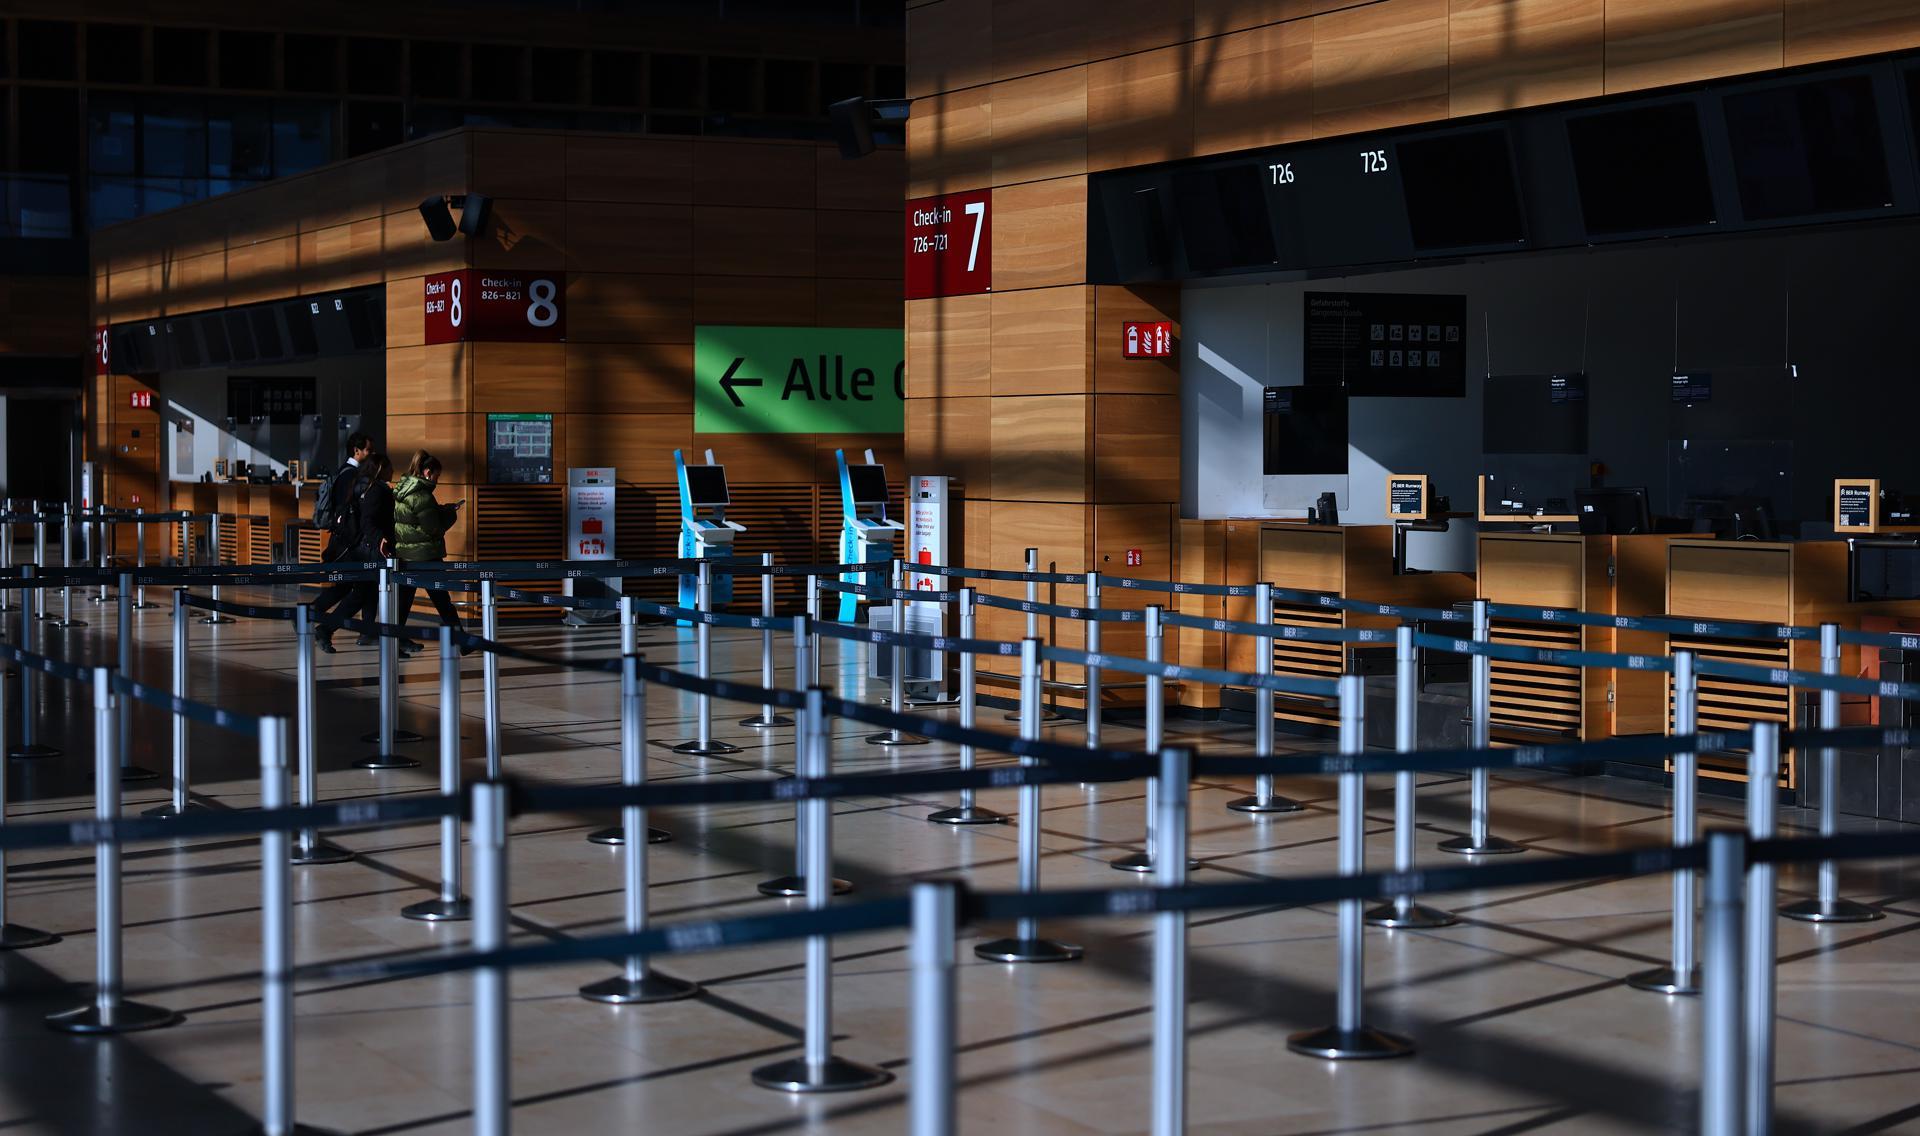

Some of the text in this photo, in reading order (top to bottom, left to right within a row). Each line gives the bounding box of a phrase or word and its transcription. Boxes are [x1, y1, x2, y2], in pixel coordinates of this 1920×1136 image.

[1360, 149, 1387, 173] 725
[1269, 162, 1294, 184] 726
[914, 206, 951, 226] Check-in
[966, 202, 984, 272] 7
[914, 234, 948, 252] 726–721
[481, 278, 522, 288] Check-in
[426, 282, 446, 295] Check-in
[482, 291, 520, 300] 826–821
[450, 278, 462, 328] 8
[527, 280, 558, 328] 8
[102, 330, 108, 365] 8
[780, 355, 875, 400] Alle
[277, 564, 291, 572] BER
[328, 574, 343, 582] BER
[568, 570, 581, 578] BER
[1122, 579, 1131, 587] BER
[1175, 584, 1184, 592] BER
[1230, 587, 1240, 595] BER
[940, 592, 948, 601] BER
[977, 595, 985, 603] BER
[1320, 597, 1330, 605] BER
[1022, 602, 1030, 611] BER
[1380, 606, 1390, 614] BER
[1071, 609, 1079, 617] BER
[1122, 612, 1130, 620] BER
[1442, 611, 1452, 619] BER
[1542, 610, 1555, 620] BER
[1214, 620, 1226, 630] BER
[1616, 617, 1628, 627] BER
[1284, 627, 1296, 637] BER
[1694, 624, 1707, 633] BER
[1777, 627, 1792, 637] BER
[1360, 630, 1372, 640] BER
[934, 638, 944, 649] BER
[1455, 641, 1468, 652] BER
[1901, 637, 1917, 648] BER
[1000, 643, 1012, 654] BER
[1538, 650, 1552, 661] BER
[1629, 656, 1644, 667] BER
[1772, 670, 1788, 682] BER
[1881, 682, 1898, 696] BER
